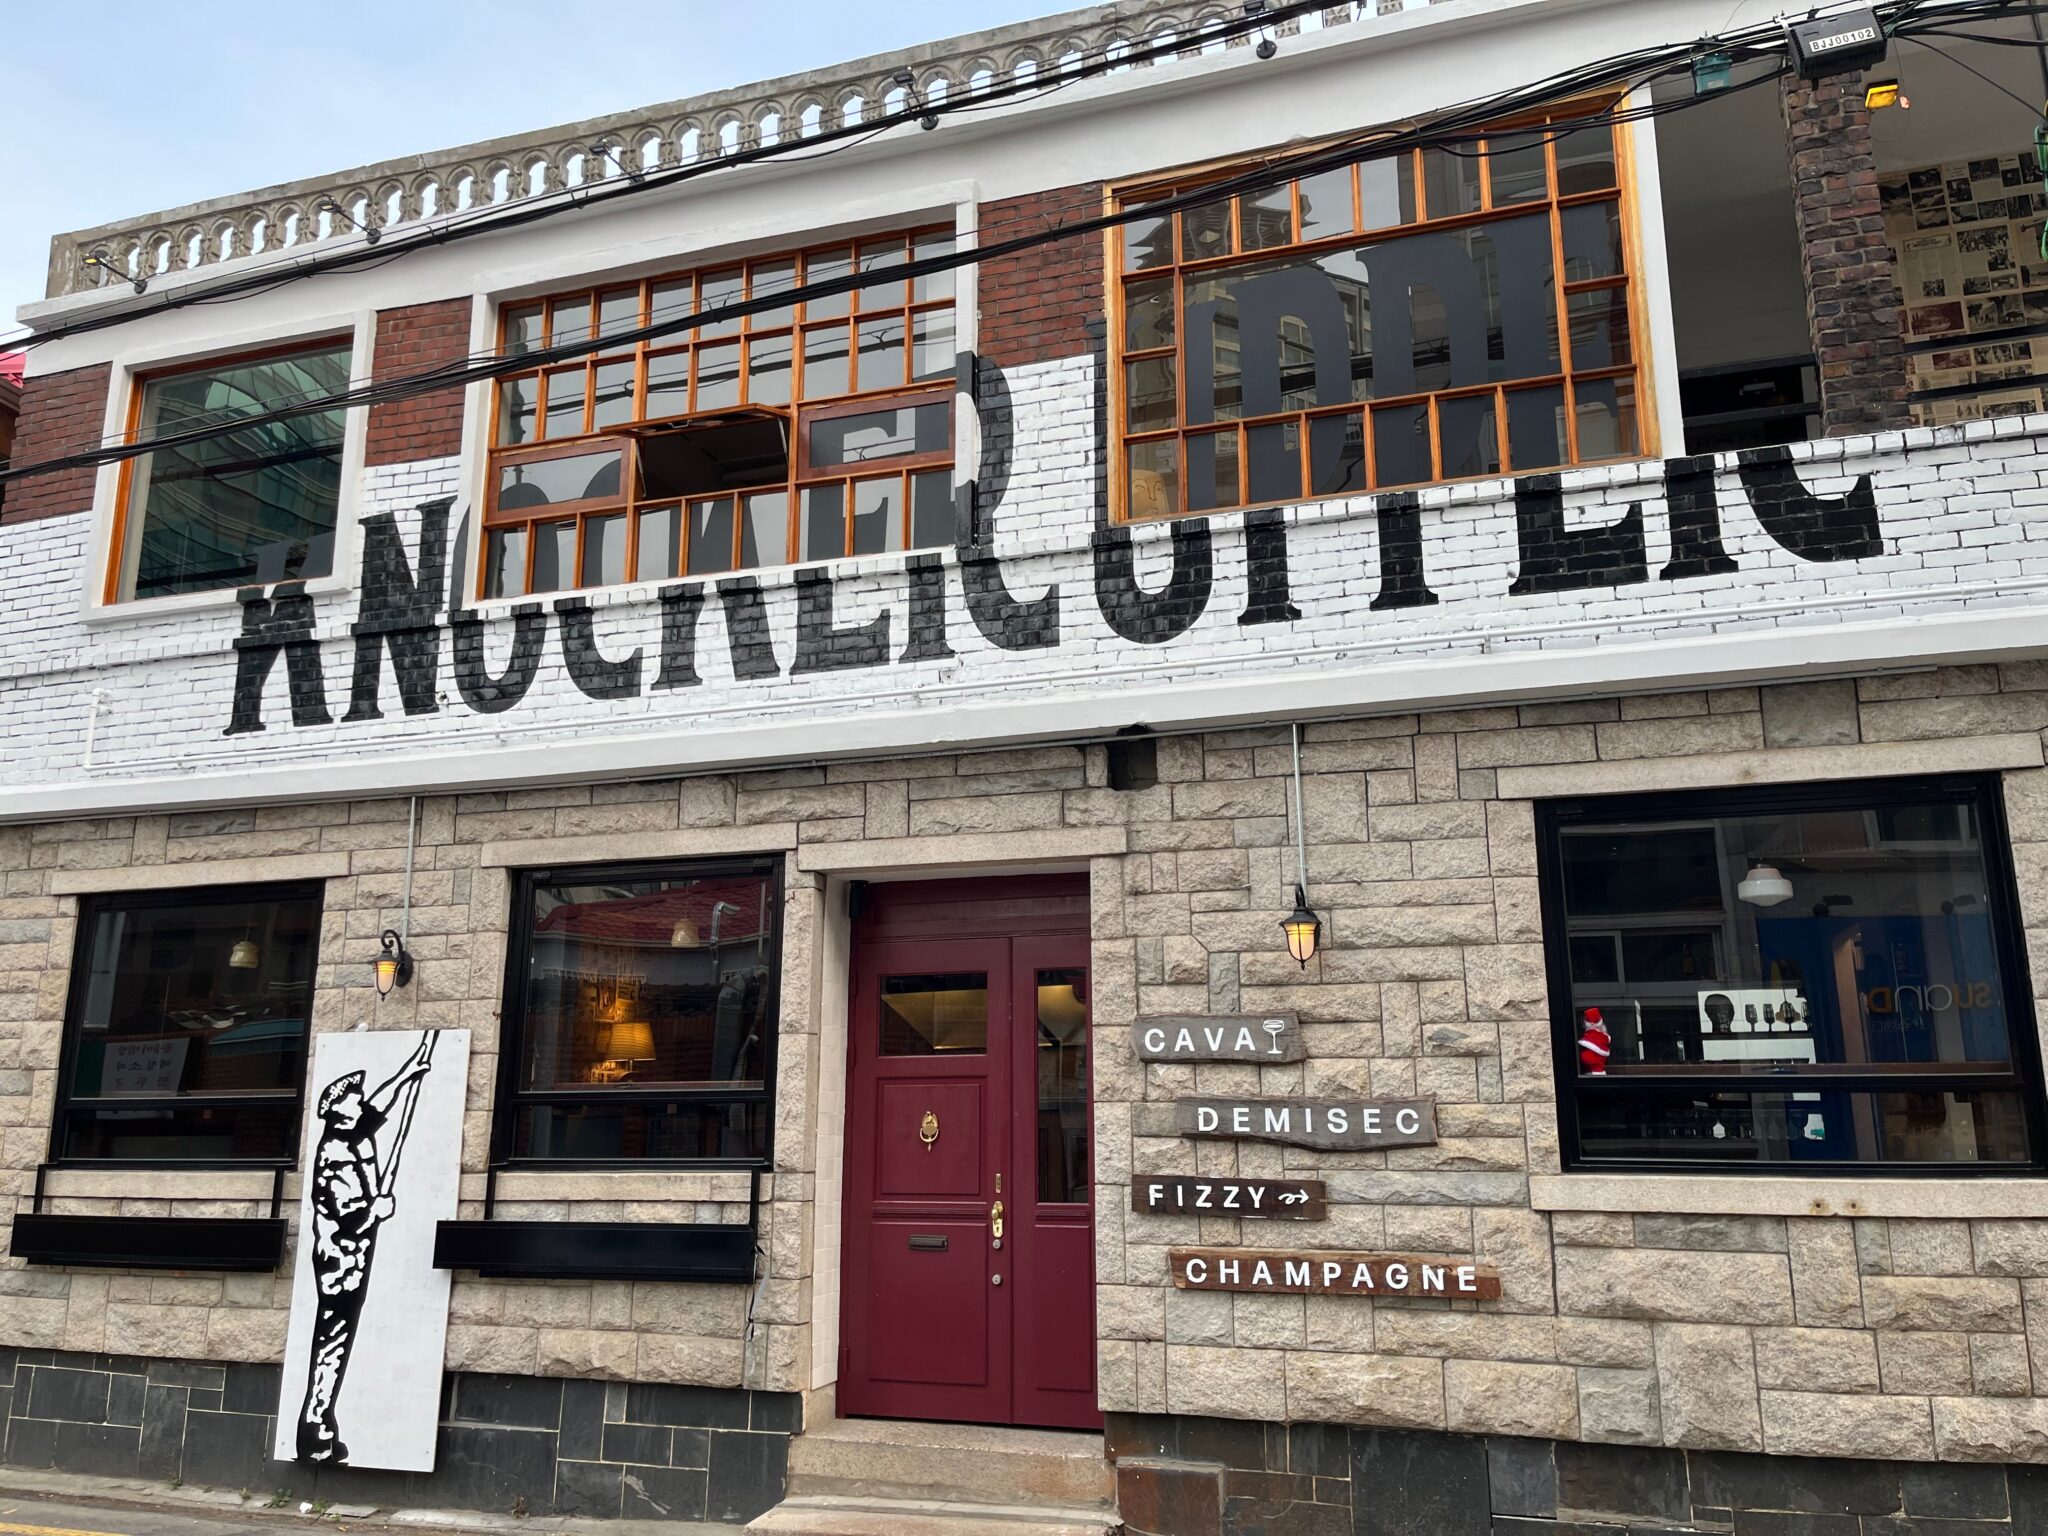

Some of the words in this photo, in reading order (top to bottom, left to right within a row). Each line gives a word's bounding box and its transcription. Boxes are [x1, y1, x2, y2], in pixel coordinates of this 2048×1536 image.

[1812, 29, 1873, 50] BJJ00102
[1144, 1026, 1256, 1053] CAVA
[1197, 1106, 1420, 1135] DEMISEC
[1148, 1184, 1266, 1209] FIZZY
[1185, 1257, 1478, 1292] CHAMPAGNE
